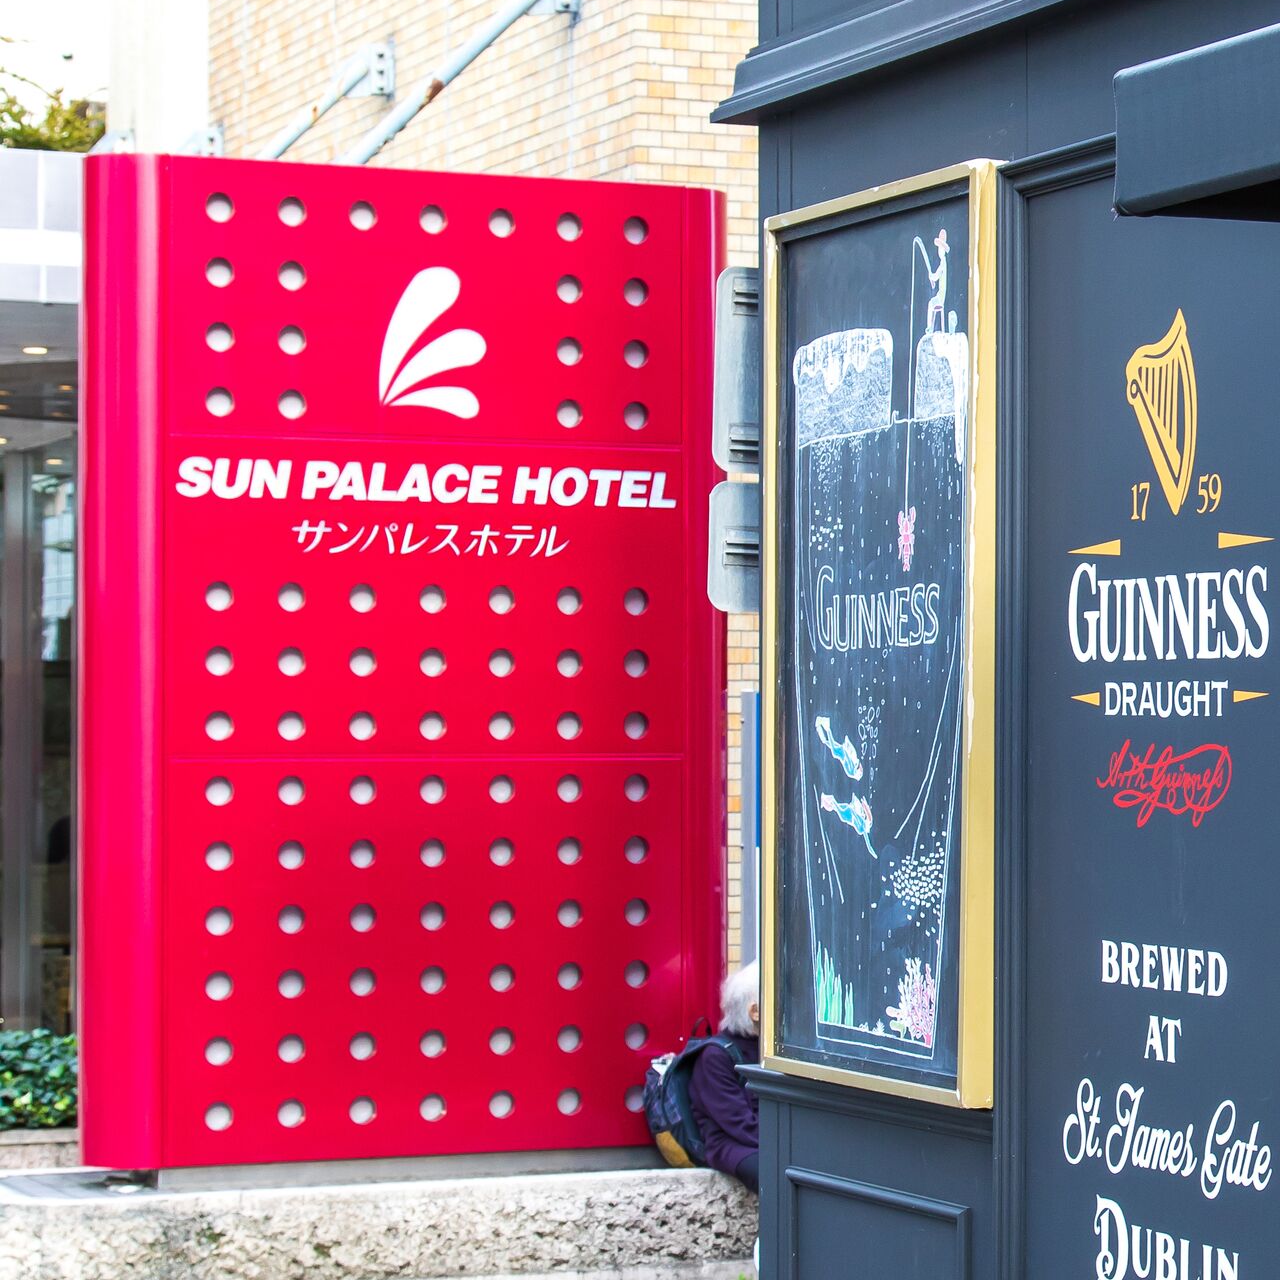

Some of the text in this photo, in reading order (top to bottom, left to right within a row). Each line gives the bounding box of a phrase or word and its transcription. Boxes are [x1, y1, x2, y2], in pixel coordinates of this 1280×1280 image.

[175, 456, 678, 509] SUN PALACE HOTEL
[1131, 473, 1222, 521] 17 59
[292, 519, 571, 558] サンパレスホテル
[815, 565, 942, 651] GUINNESS
[1068, 562, 1271, 663] GUINNESS
[1104, 680, 1229, 718] DRAUGHT
[1101, 939, 1229, 997] BREWED
[1144, 1015, 1182, 1063] AT
[1063, 1078, 1273, 1200] St. James Gate
